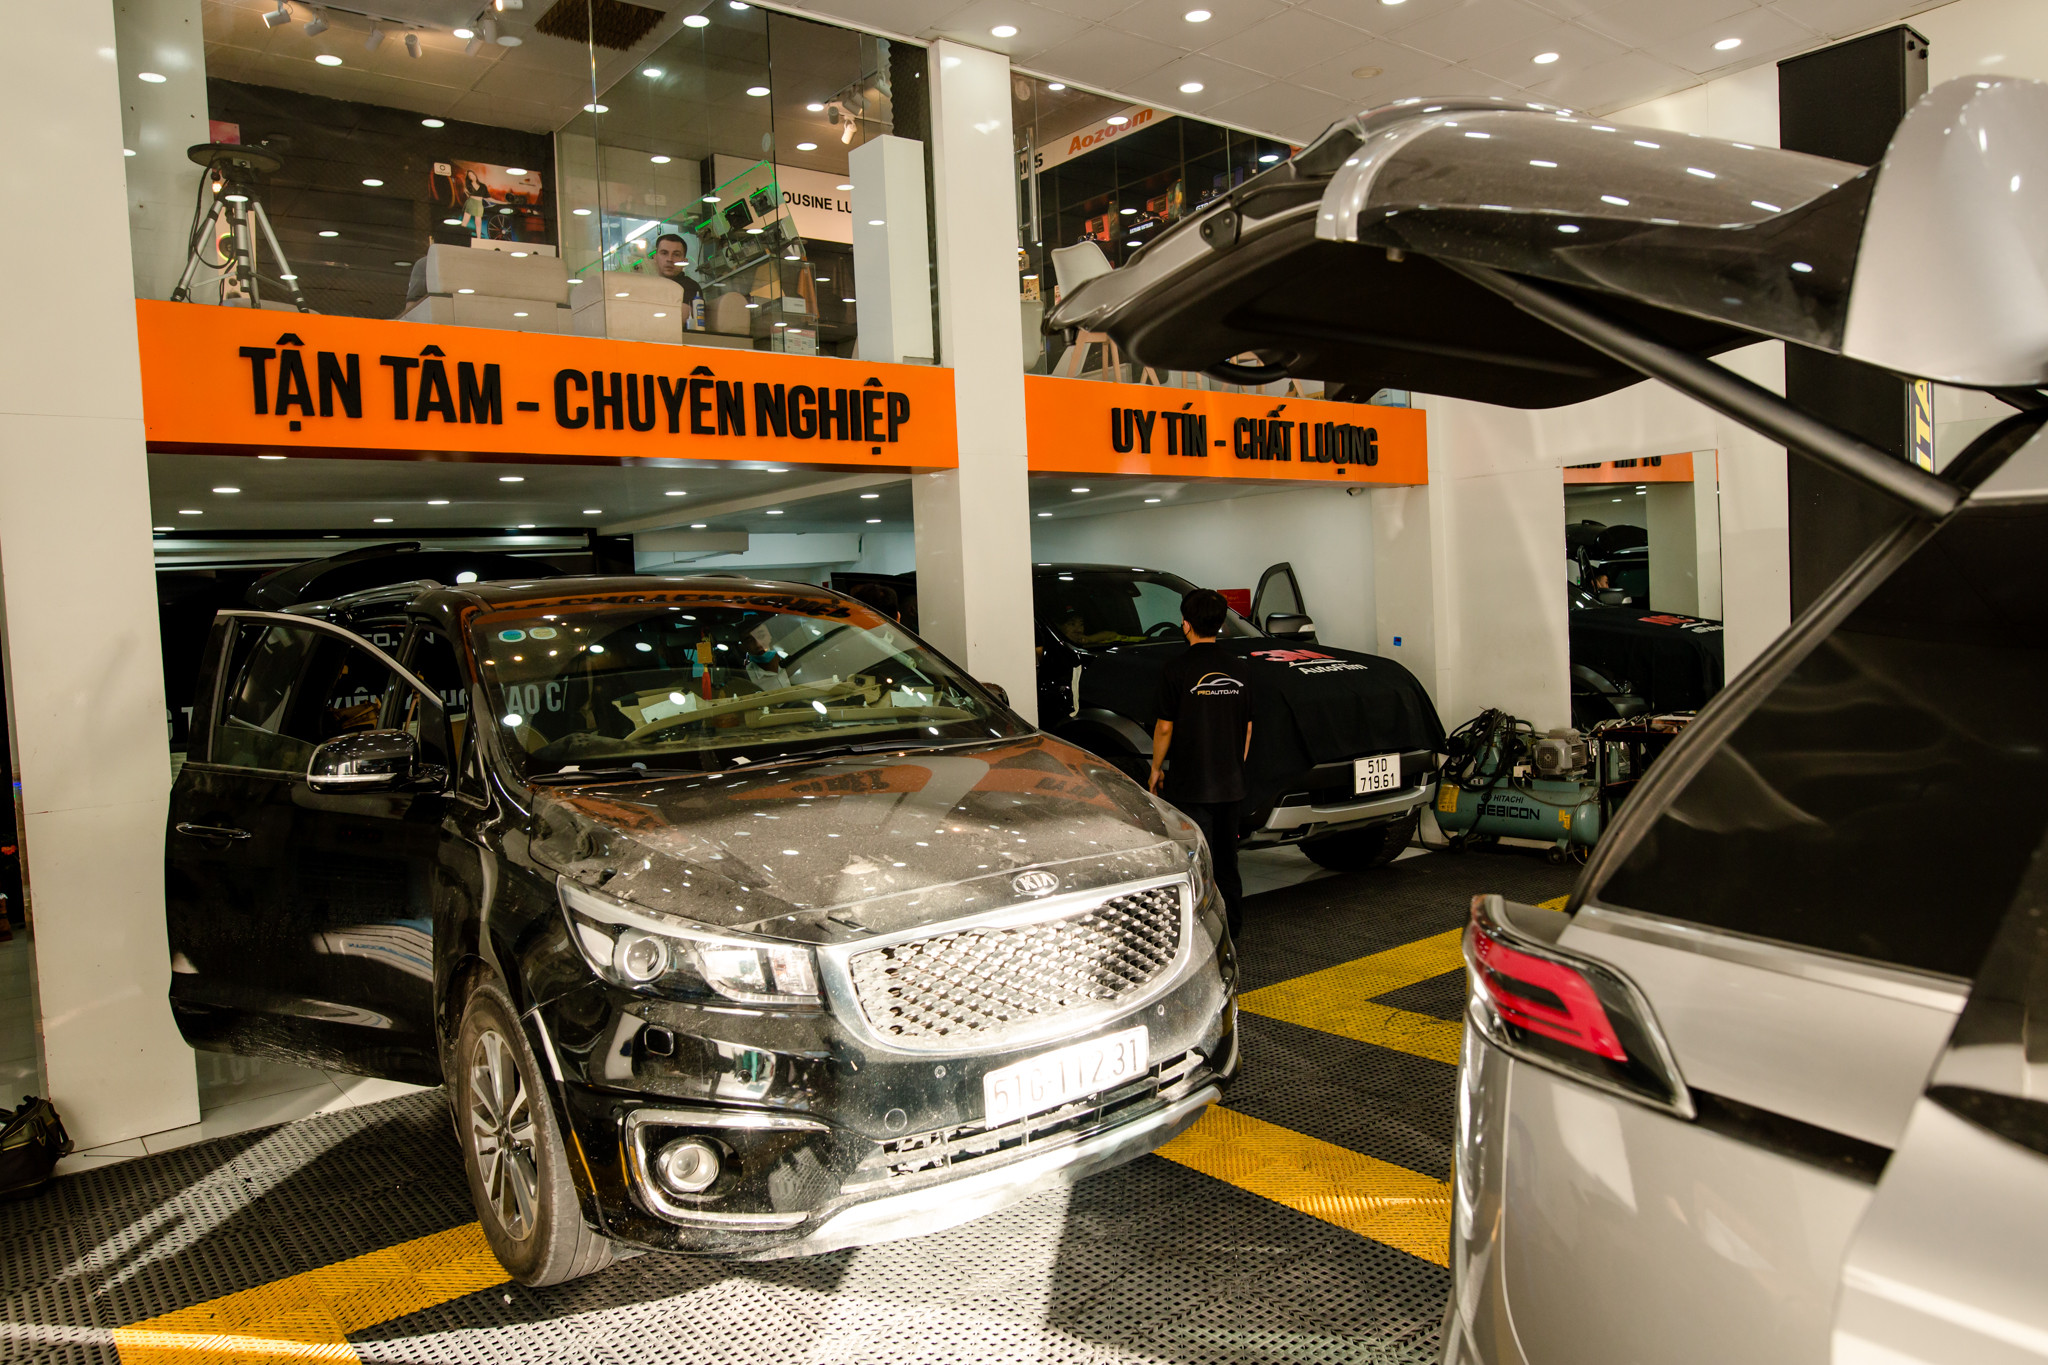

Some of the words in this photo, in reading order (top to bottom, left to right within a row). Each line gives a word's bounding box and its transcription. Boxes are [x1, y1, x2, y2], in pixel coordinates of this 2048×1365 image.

[1068, 108, 1153, 155] Aozoom
[782, 191, 832, 210] OUSINE
[837, 200, 852, 213] LU
[239, 333, 362, 431] TẬN
[380, 345, 503, 425] TÂM
[554, 366, 743, 436] CHUYÊN
[754, 377, 910, 455] NGHIỆP
[1111, 407, 1156, 454] UY
[1161, 402, 1208, 457] TÍN
[1233, 399, 1294, 461] CHẤT
[1368, 758, 1387, 774] 51D
[1360, 773, 1395, 791] 719.61
[1493, 794, 1524, 804] HITACHI
[1018, 872, 1055, 892] KIA
